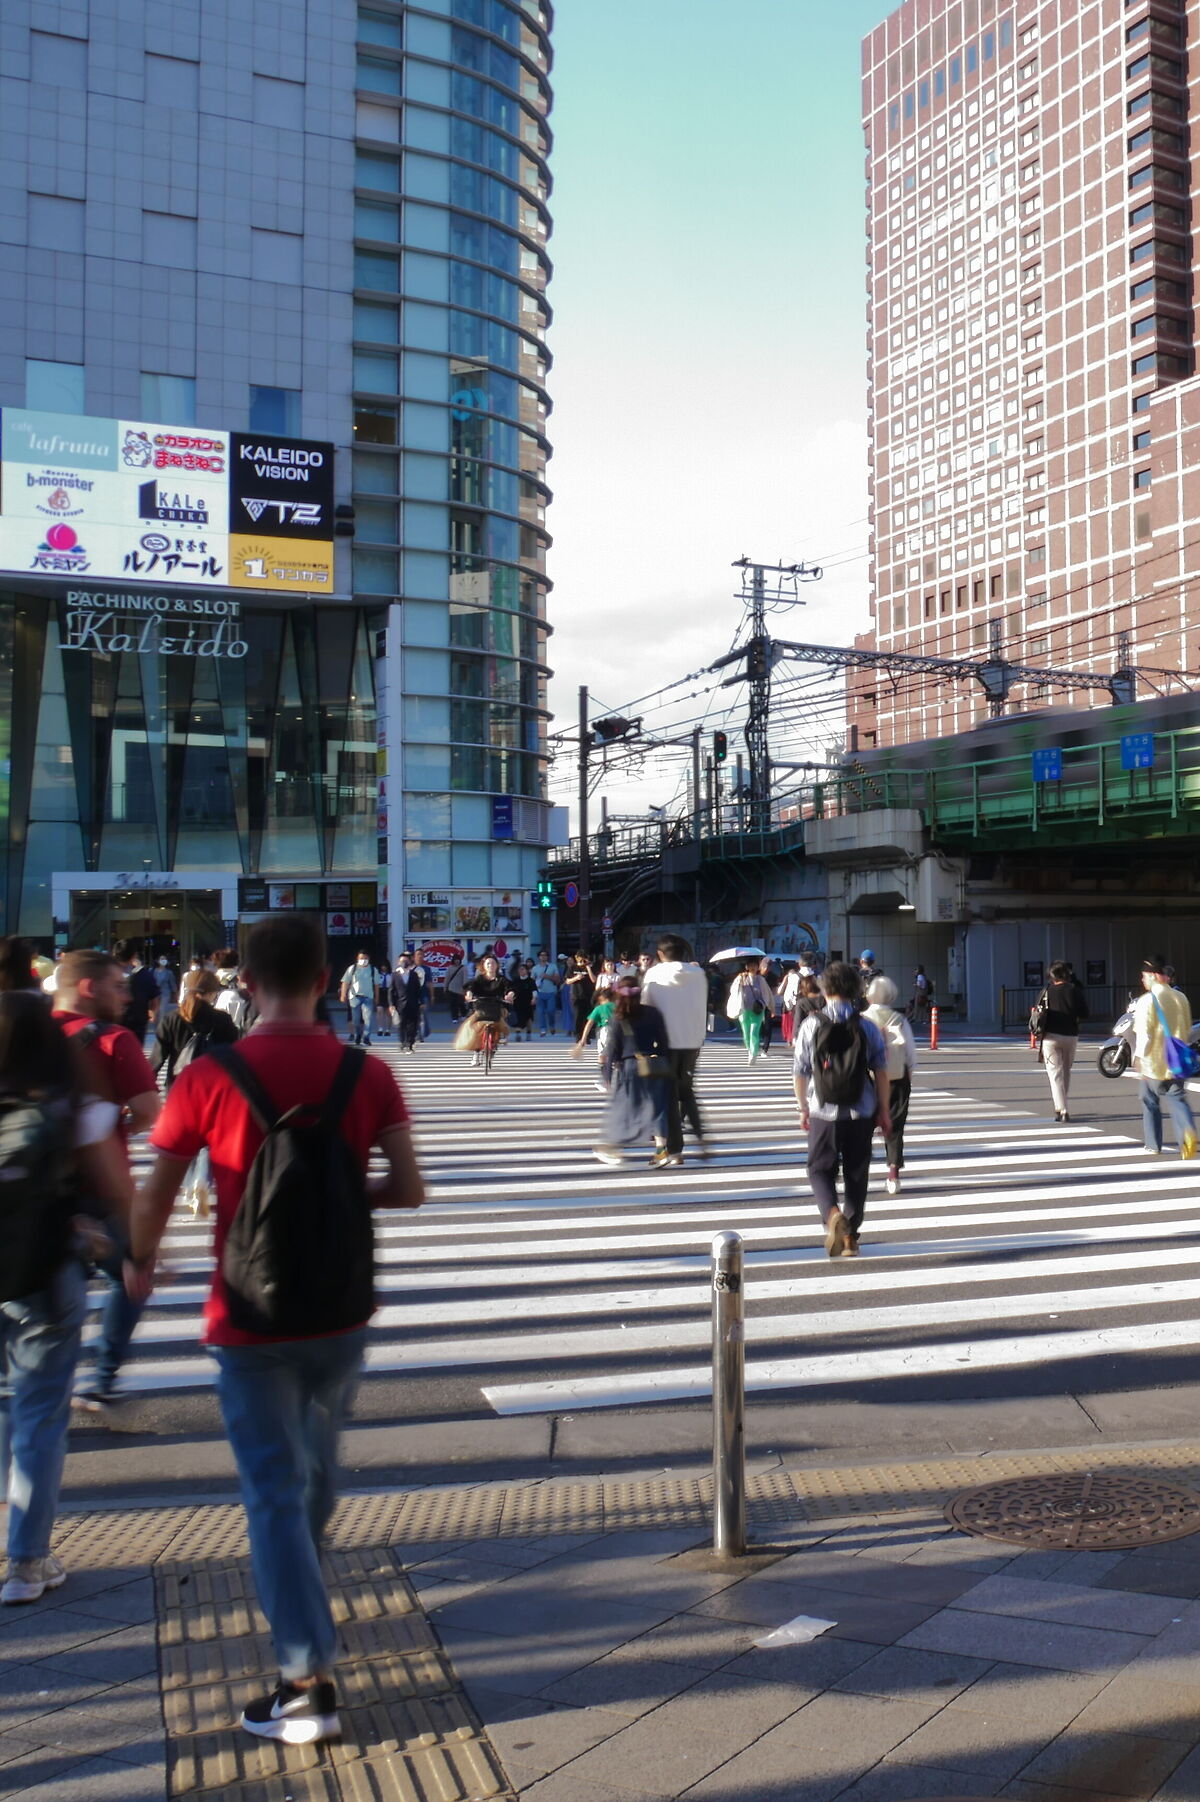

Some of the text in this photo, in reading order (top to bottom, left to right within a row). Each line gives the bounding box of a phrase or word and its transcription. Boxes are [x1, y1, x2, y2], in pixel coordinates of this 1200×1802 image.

[163, 434, 215, 452] カラオケ
[153, 448, 225, 475] まねきねこ
[240, 444, 324, 468] KALEIDO
[26, 472, 95, 493] b-monster
[254, 463, 309, 482] VISION
[158, 491, 206, 510] KALe
[157, 508, 206, 522] CHIKA
[122, 550, 223, 578] ルノアール
[272, 567, 330, 583] ワンカラ
[66, 590, 241, 617] PACHINKO & SLOT
[55, 609, 250, 660] Kaleido
[410, 893, 427, 905] B1F
